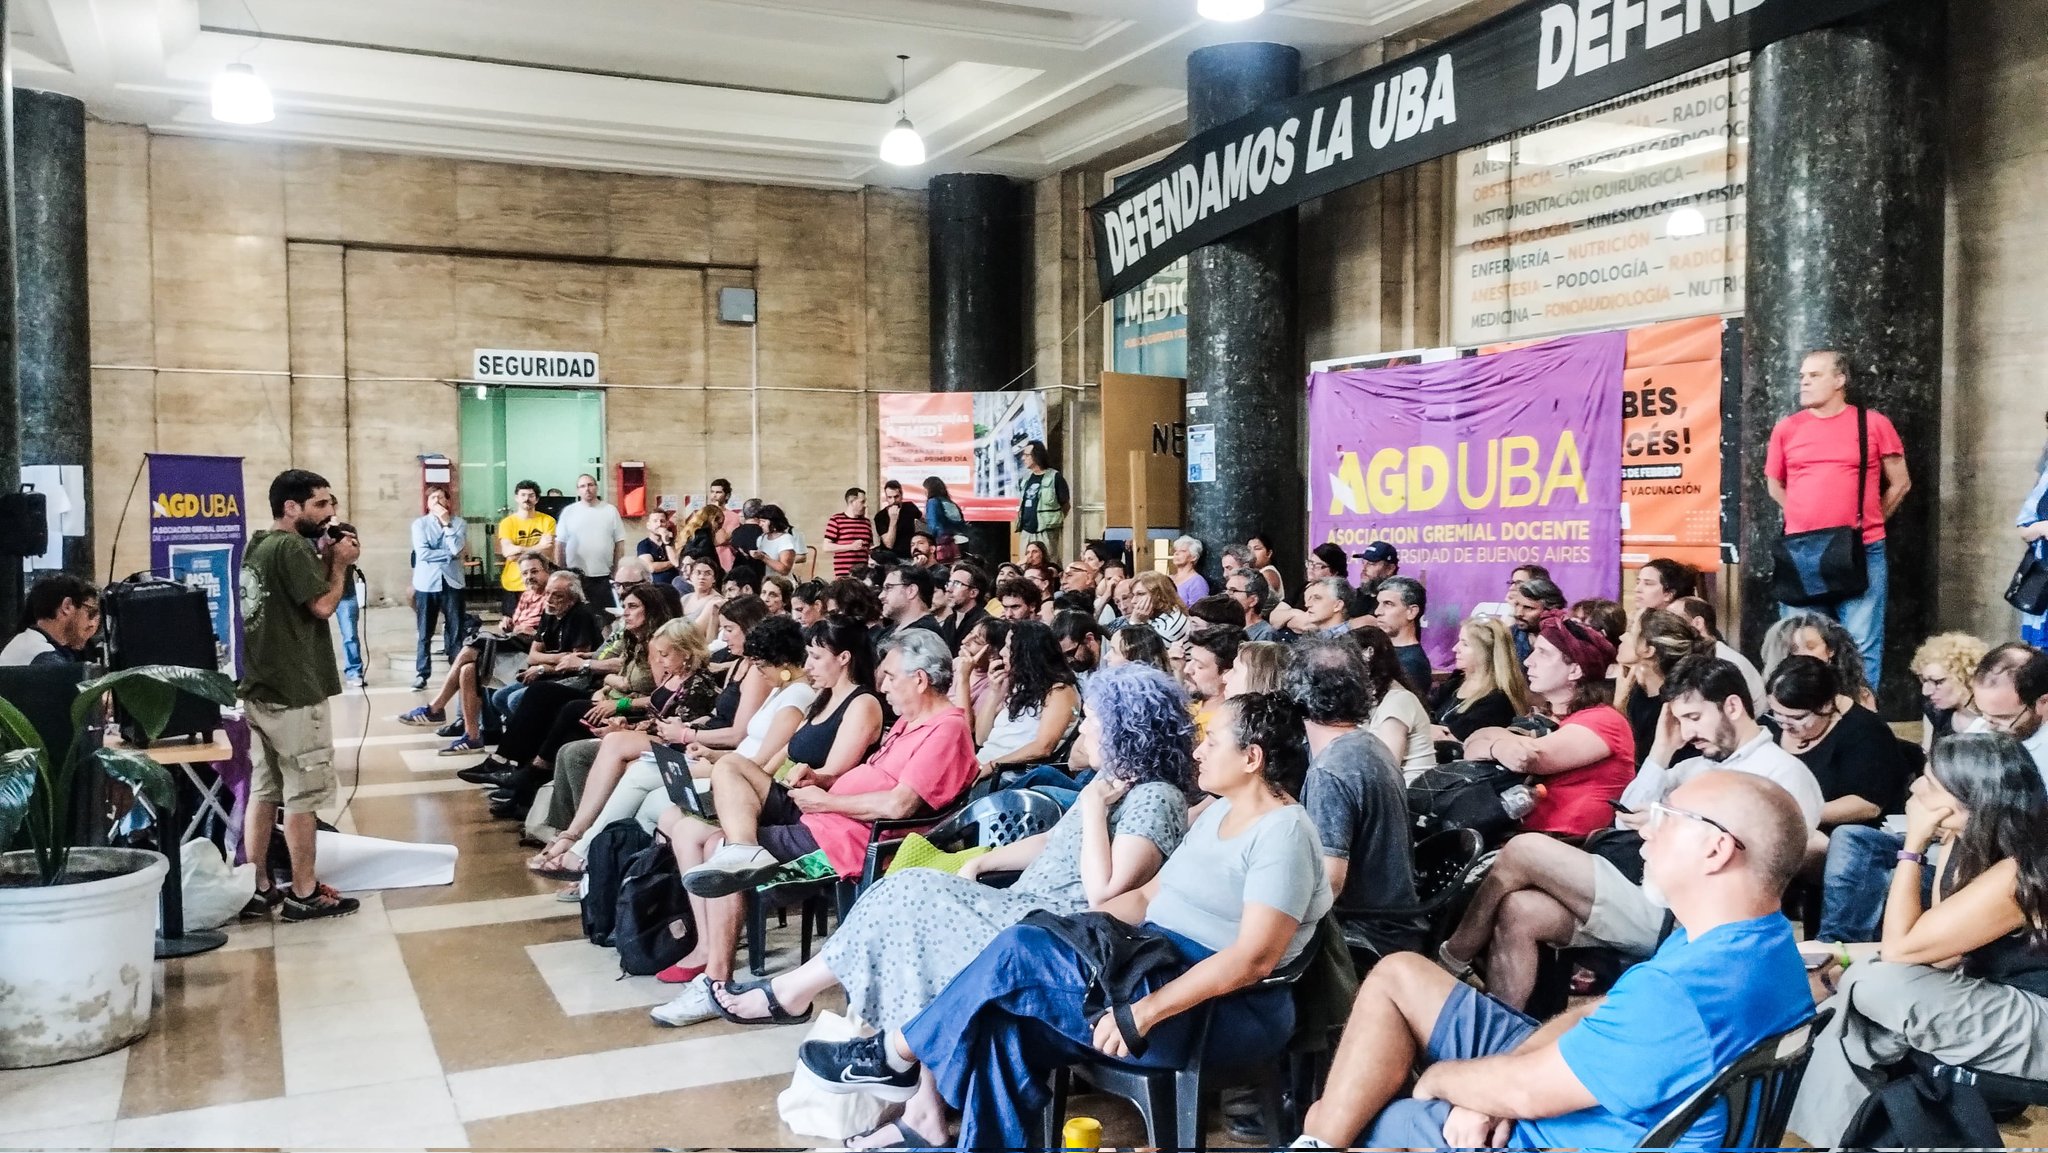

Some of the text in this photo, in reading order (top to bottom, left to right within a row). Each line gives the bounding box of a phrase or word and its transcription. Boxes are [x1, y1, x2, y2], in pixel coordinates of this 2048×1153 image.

[1104, 117, 1300, 276] DEFENDAMOS
[1305, 96, 1353, 174] LA
[1368, 53, 1457, 150] UBA
[1473, 170, 1552, 202] OBSTETRICIA
[1473, 185, 1590, 228] INSTRUMENTACIÓN
[1593, 165, 1684, 200] QUIRÚRGICA
[1471, 247, 1550, 279] ENFERMERÍA
[1568, 229, 1650, 261] NUTRICIÓN
[1471, 279, 1540, 304] ANESTESIA
[1556, 258, 1649, 290] PODOLOGÍA
[1471, 306, 1529, 328] MEDICINA
[1545, 282, 1671, 318] FONOAUDIOLOGÍA
[478, 354, 596, 378] SEGURIDAD
[1622, 421, 1692, 457] CÉS!
[1328, 430, 1590, 516] AGD UBA
[1630, 482, 1701, 496] VACUNACIÓN
[152, 492, 240, 518] AGD UBA
[1422, 522, 1496, 544] GREMIAL
[1501, 520, 1590, 541] DOCENTE
[1453, 548, 1472, 563] DE
[1476, 546, 1540, 563] BUENOS
[1544, 545, 1591, 563] AIRES
